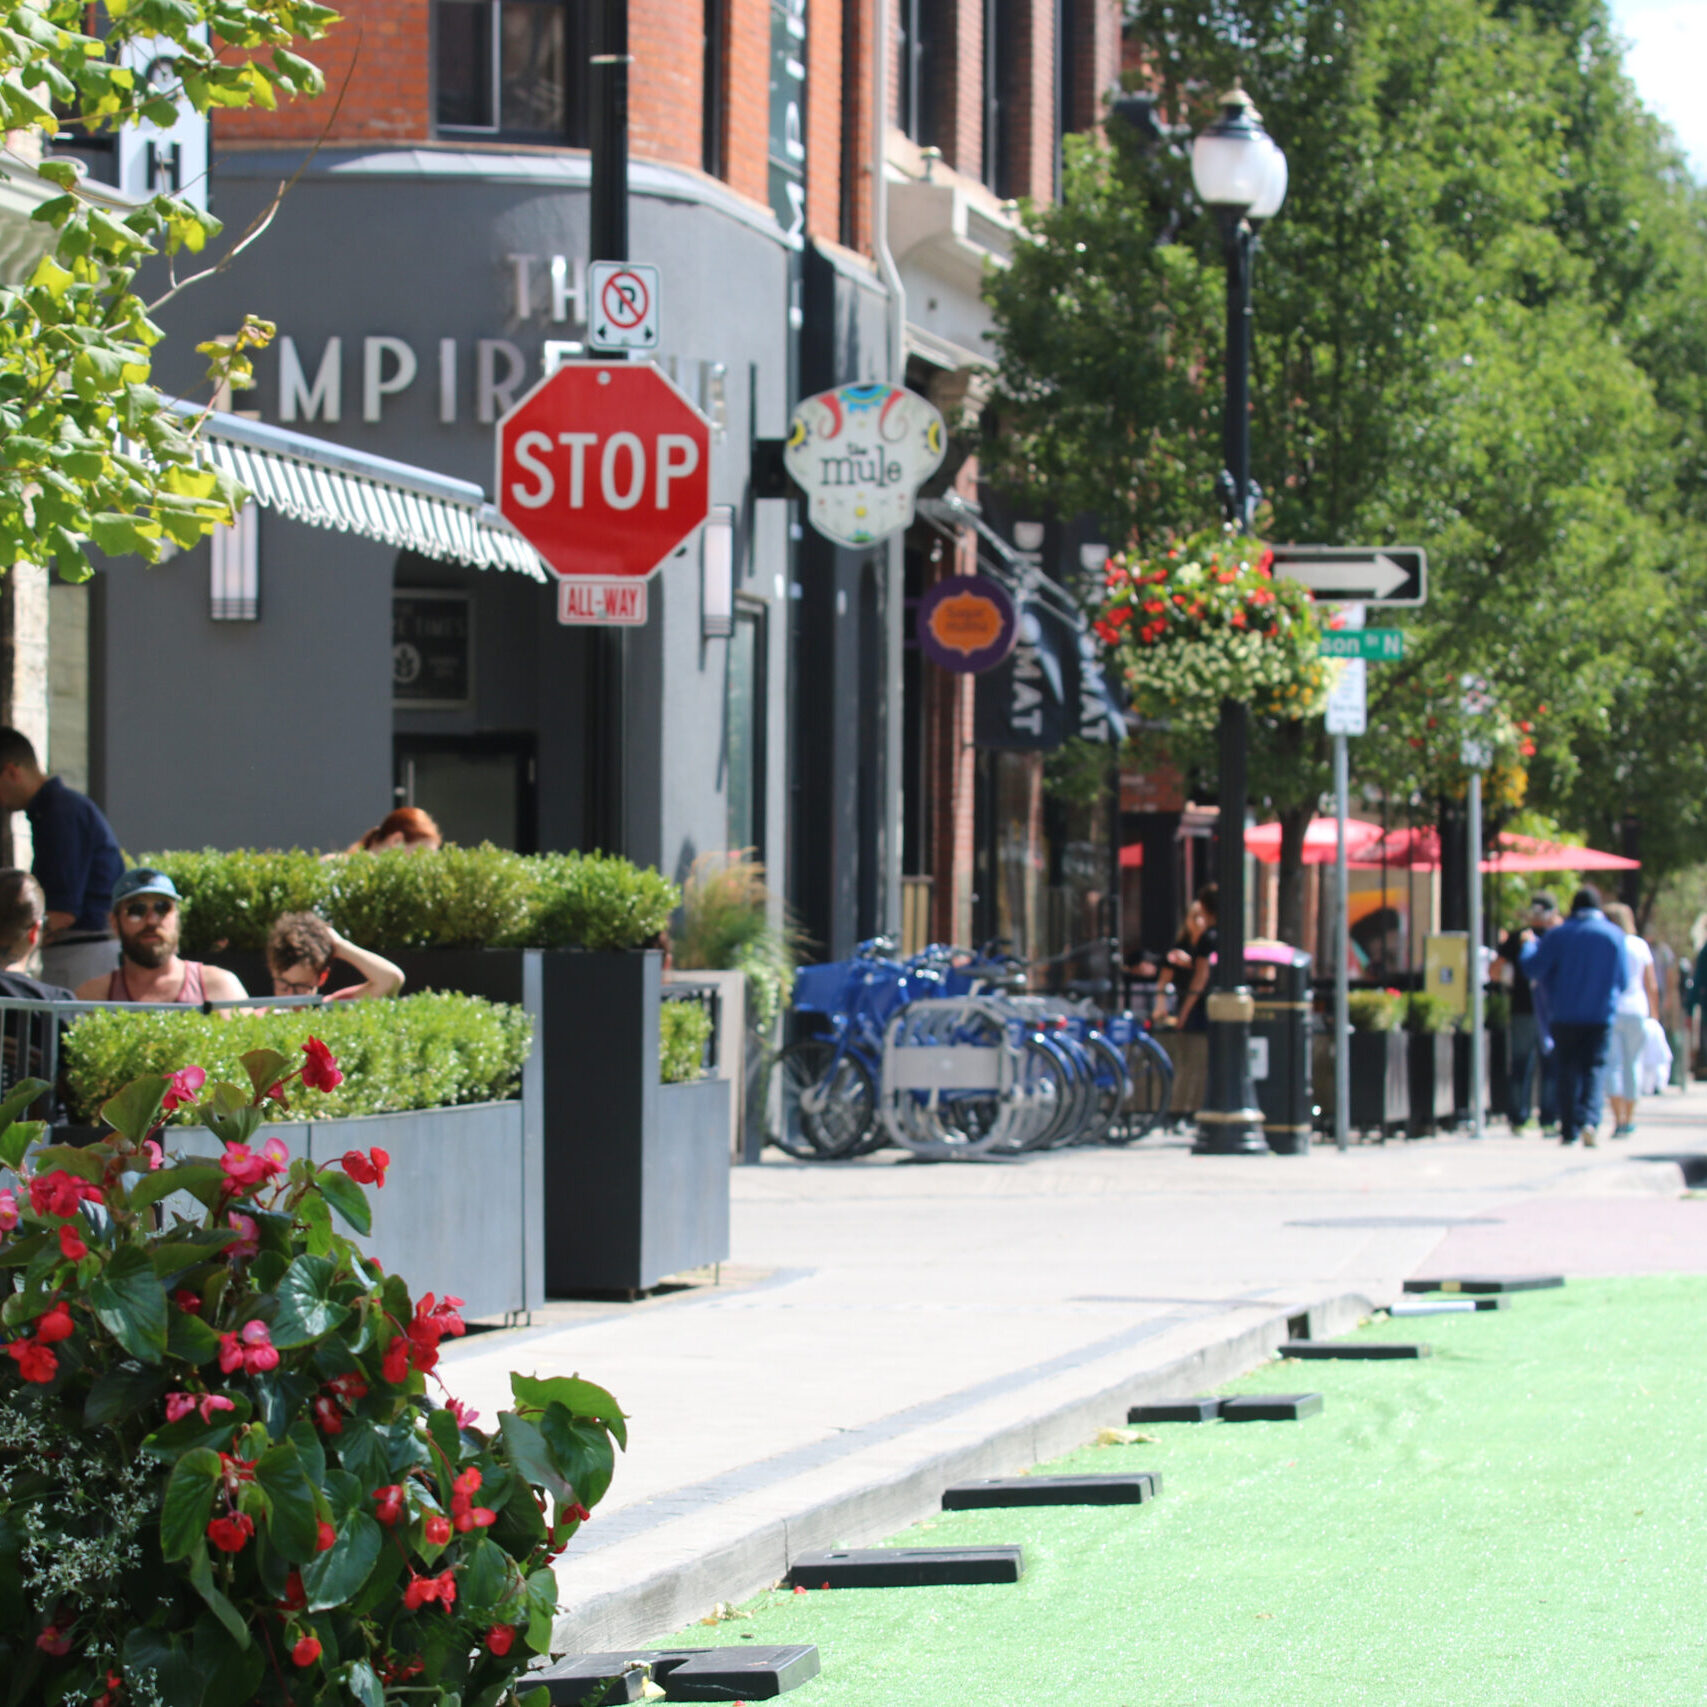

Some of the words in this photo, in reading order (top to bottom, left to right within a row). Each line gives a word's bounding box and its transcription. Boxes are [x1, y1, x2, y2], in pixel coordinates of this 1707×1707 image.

[506, 253, 587, 324] TH
[820, 444, 902, 487] mule
[846, 442, 868, 455] the
[511, 430, 699, 511] STOP
[566, 587, 639, 617] ALL-WAY
[1321, 636, 1360, 654] son
[1384, 634, 1399, 655] N
